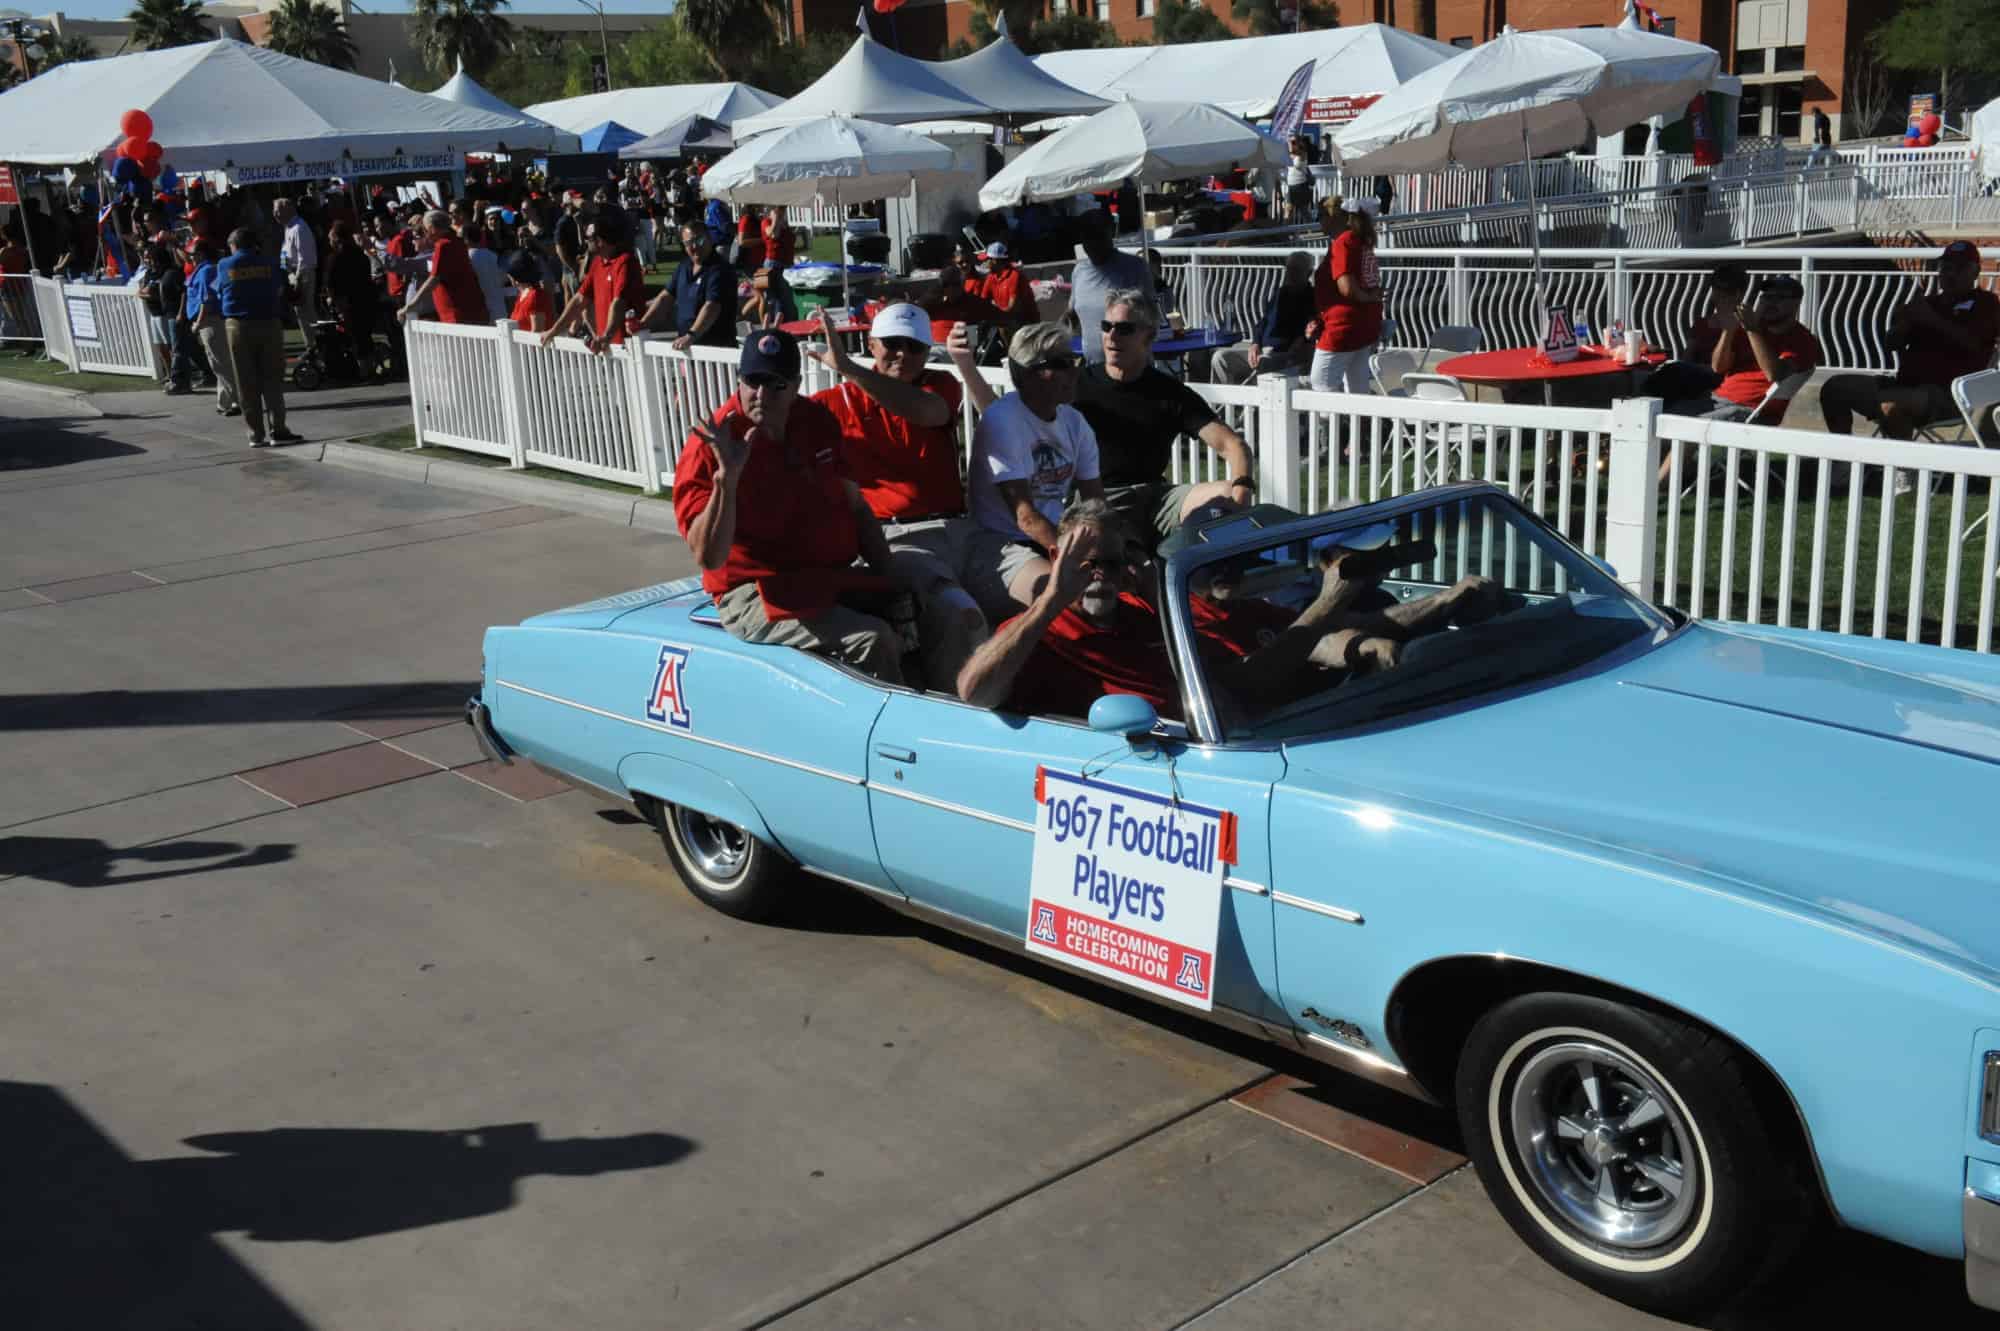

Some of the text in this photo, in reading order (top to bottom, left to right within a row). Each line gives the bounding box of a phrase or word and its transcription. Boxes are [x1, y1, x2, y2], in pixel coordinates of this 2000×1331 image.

[238, 165, 282, 182] COLLEGE
[286, 163, 300, 178] OF
[304, 160, 337, 177] SOCIAL
[352, 157, 409, 174] BEHAVIORAL
[646, 643, 691, 730] A
[1046, 795, 1217, 874] 1967 Football
[1073, 854, 1166, 922] Players
[1065, 933, 1169, 981] CELEBRATION
[1066, 915, 1169, 962] HOMECOMING
